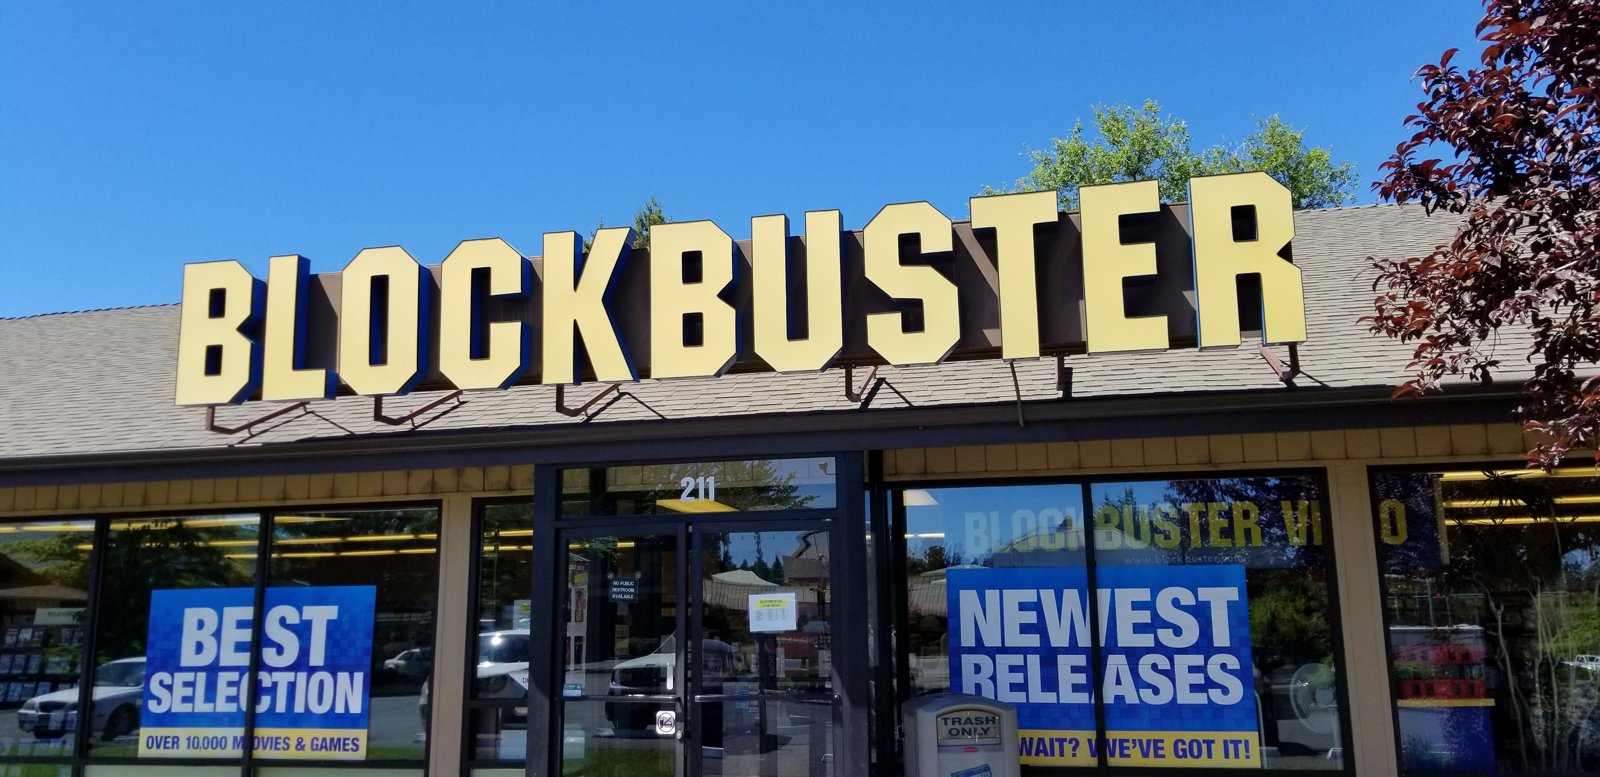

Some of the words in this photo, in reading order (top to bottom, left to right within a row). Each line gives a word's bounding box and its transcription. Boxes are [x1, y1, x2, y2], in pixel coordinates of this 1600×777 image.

[175, 171, 1306, 406] BLOCKBUSTER
[680, 476, 715, 503] 211
[964, 501, 1262, 554] BLOCKBUSTER
[180, 605, 339, 668] BEST
[959, 586, 1240, 649] NEWEST
[148, 671, 364, 716] SELECTION
[961, 654, 1244, 705] RELEASES
[942, 716, 996, 726] TRASH
[948, 727, 991, 737] ONLY
[146, 735, 180, 750] OVER
[185, 735, 228, 751] 10,000
[232, 736, 290, 752] MOVIES
[295, 737, 306, 751] &
[310, 737, 361, 753] GAMES
[1019, 737, 1080, 758] WAIT?
[1087, 738, 1166, 760] WE'VE
[1173, 739, 1216, 760] GOT
[1223, 739, 1251, 760] IT!
